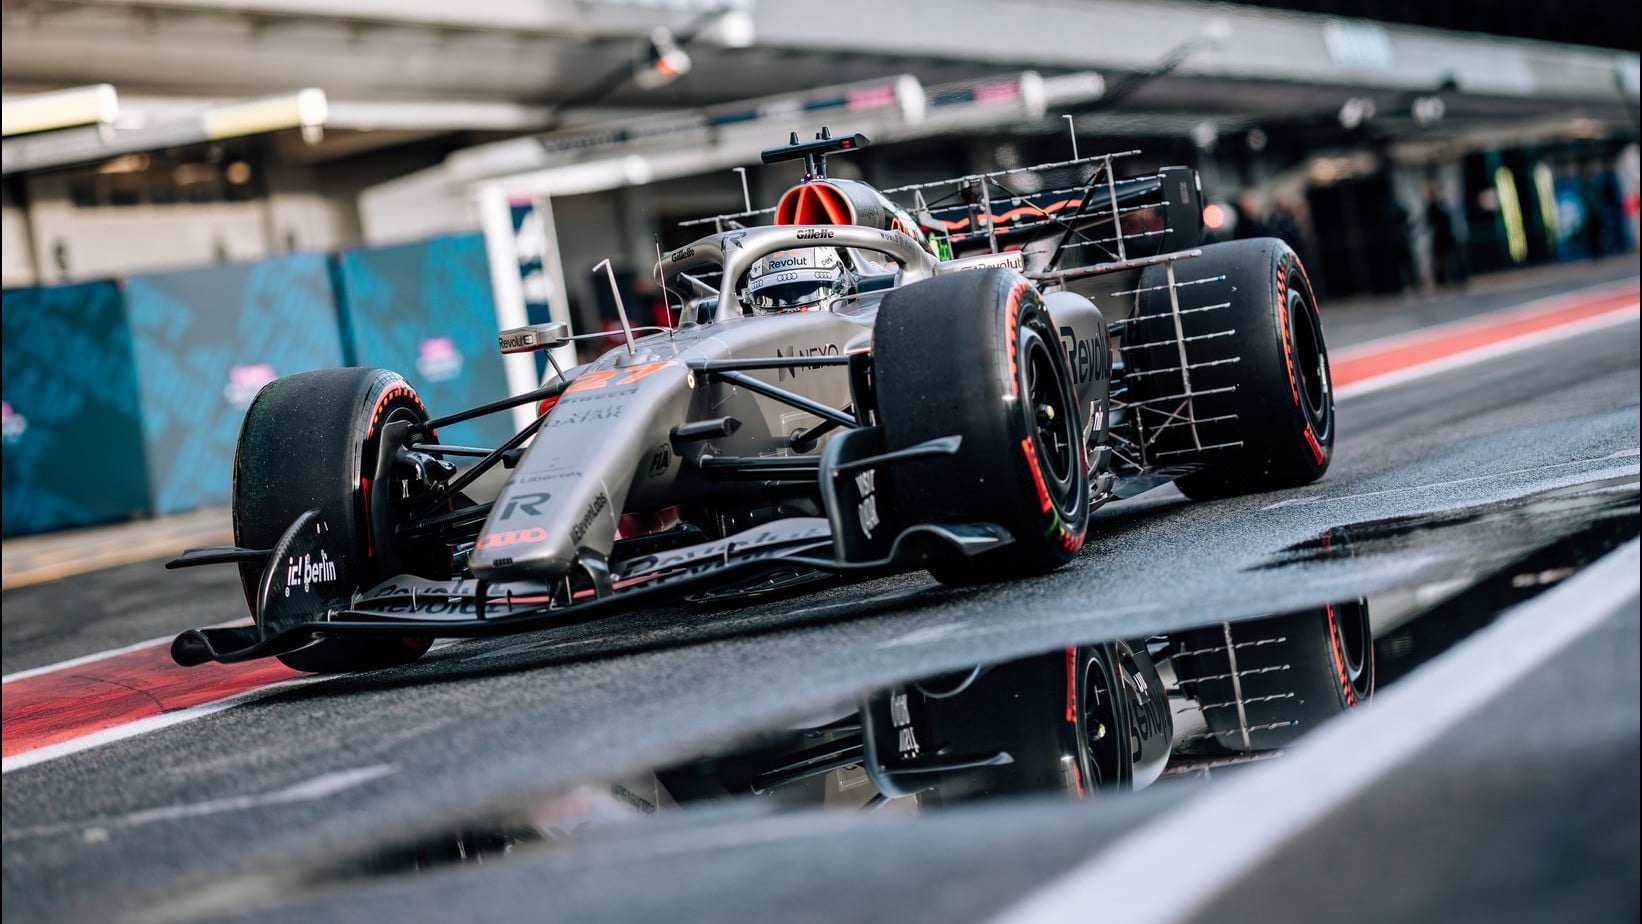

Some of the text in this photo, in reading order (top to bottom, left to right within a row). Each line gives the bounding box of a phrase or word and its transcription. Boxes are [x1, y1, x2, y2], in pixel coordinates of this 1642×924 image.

[796, 229, 835, 240] Gillette
[671, 248, 695, 263] Gillette
[768, 256, 808, 270] Revolut
[498, 336, 525, 349] Revolut
[565, 360, 679, 393] 27
[304, 550, 336, 590] berlin
